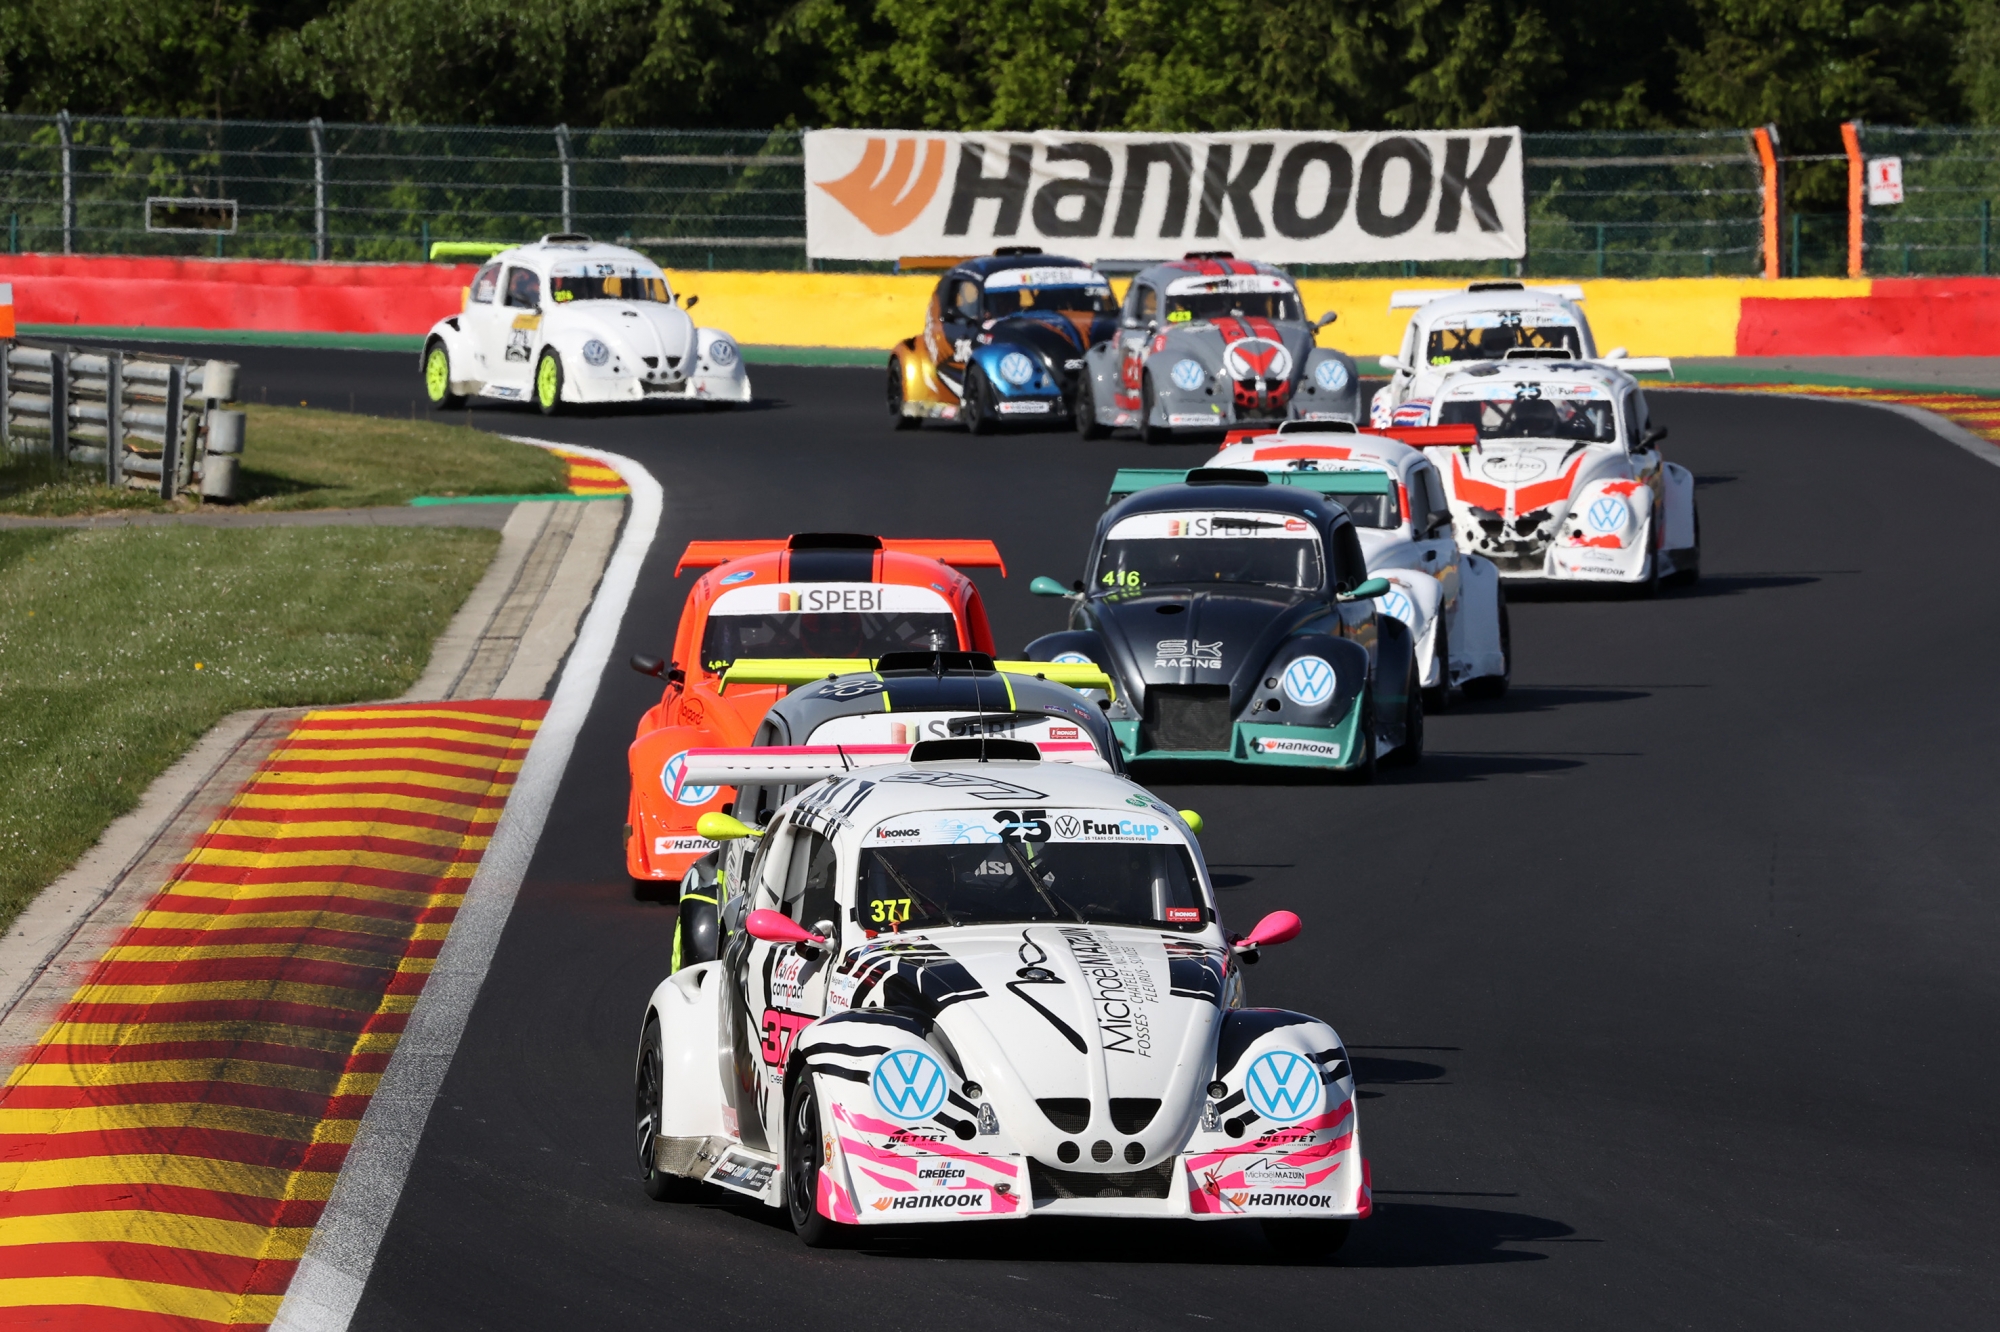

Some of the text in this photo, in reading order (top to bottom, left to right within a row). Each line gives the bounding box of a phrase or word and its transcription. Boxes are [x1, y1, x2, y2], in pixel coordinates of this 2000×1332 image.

[1514, 382, 1542, 400] 25
[1589, 498, 1627, 532] VW
[1102, 571, 1140, 587] 416
[809, 588, 884, 611] SPEBI
[1156, 639, 1223, 657] SK
[1154, 658, 1222, 669] RACING
[1286, 658, 1334, 705] VW
[876, 826, 920, 837] KRONOS
[993, 809, 1051, 842] 25
[1083, 820, 1159, 841] FunCup
[674, 839, 720, 850] Hanko
[870, 898, 911, 922] 377
[773, 979, 804, 1006] compact
[830, 990, 849, 1008] TOTAL
[1134, 1013, 1152, 1058] FOSSES
[873, 1050, 946, 1120] VW
[1246, 1051, 1319, 1122] VW
[888, 1135, 948, 1143] METTET
[1259, 1135, 1317, 1143] METTET
[918, 1169, 966, 1179] CREDECO
